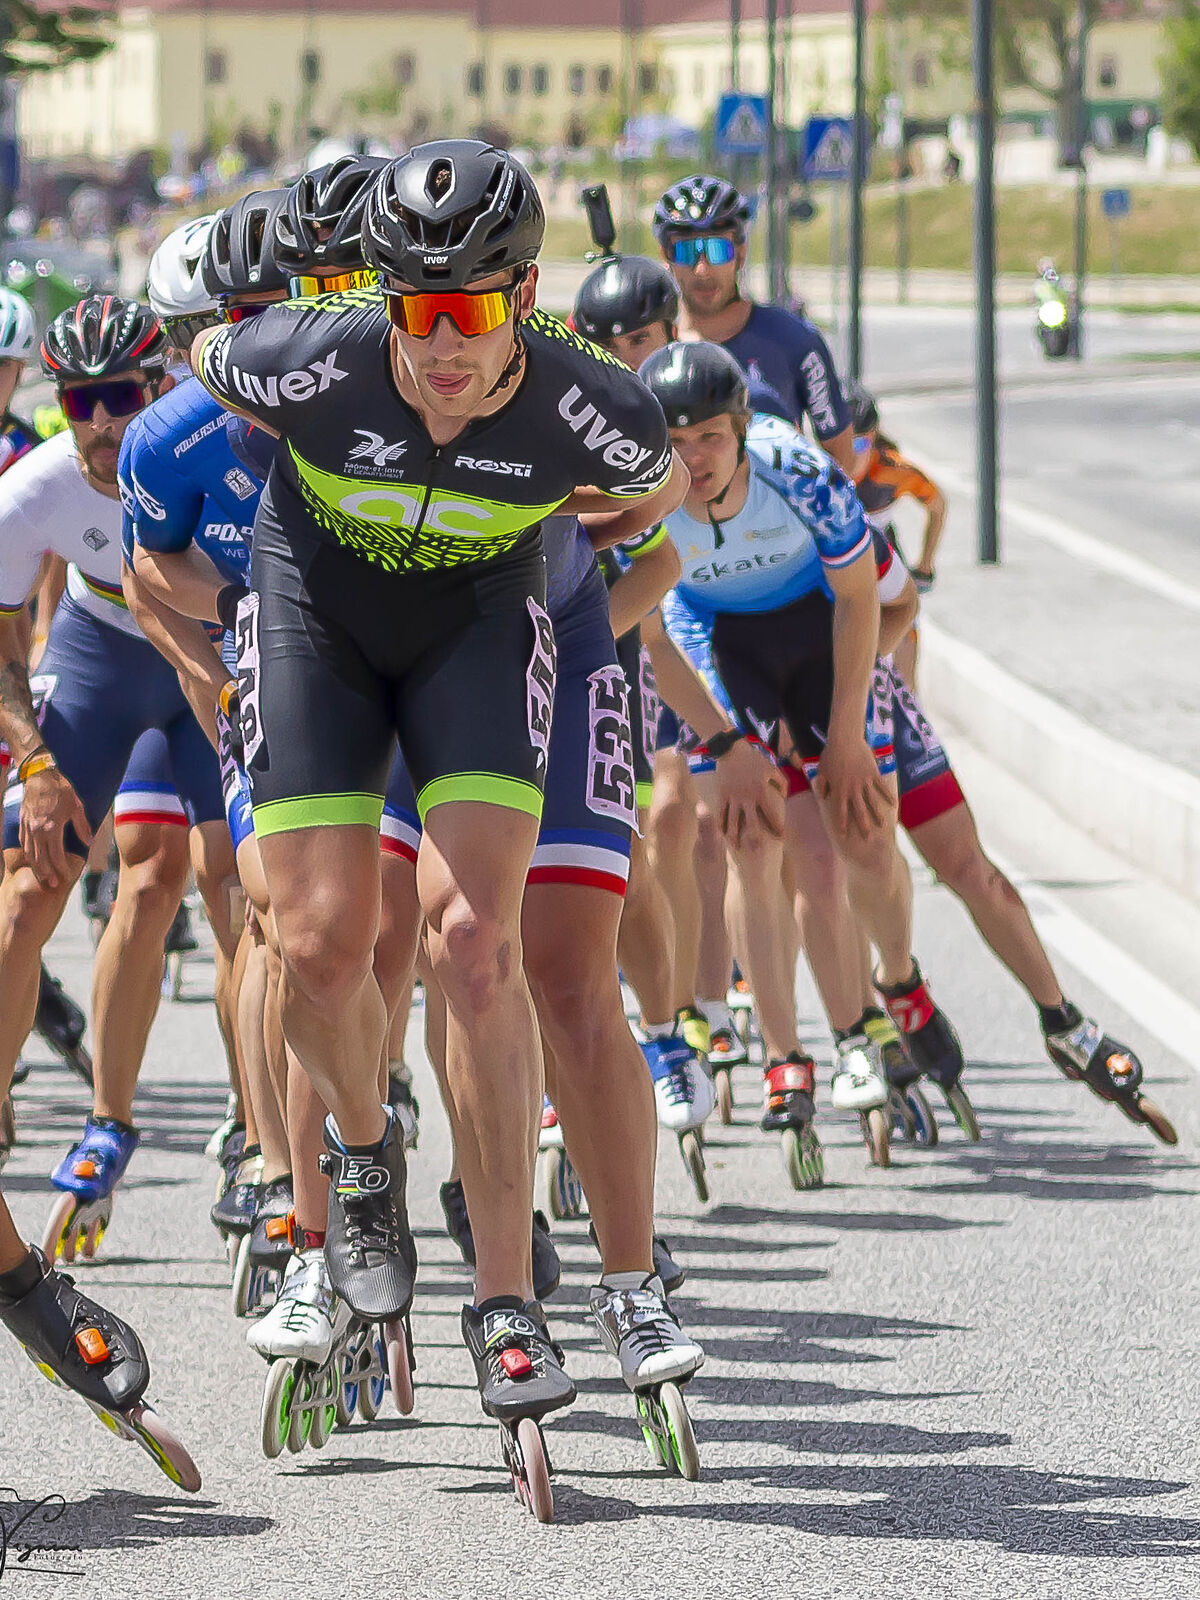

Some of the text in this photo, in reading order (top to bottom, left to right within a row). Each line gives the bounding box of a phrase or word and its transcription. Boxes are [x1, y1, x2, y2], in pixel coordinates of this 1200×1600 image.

[232, 349, 350, 407] uvex
[558, 384, 653, 473] uvex
[592, 674, 634, 812] 535
